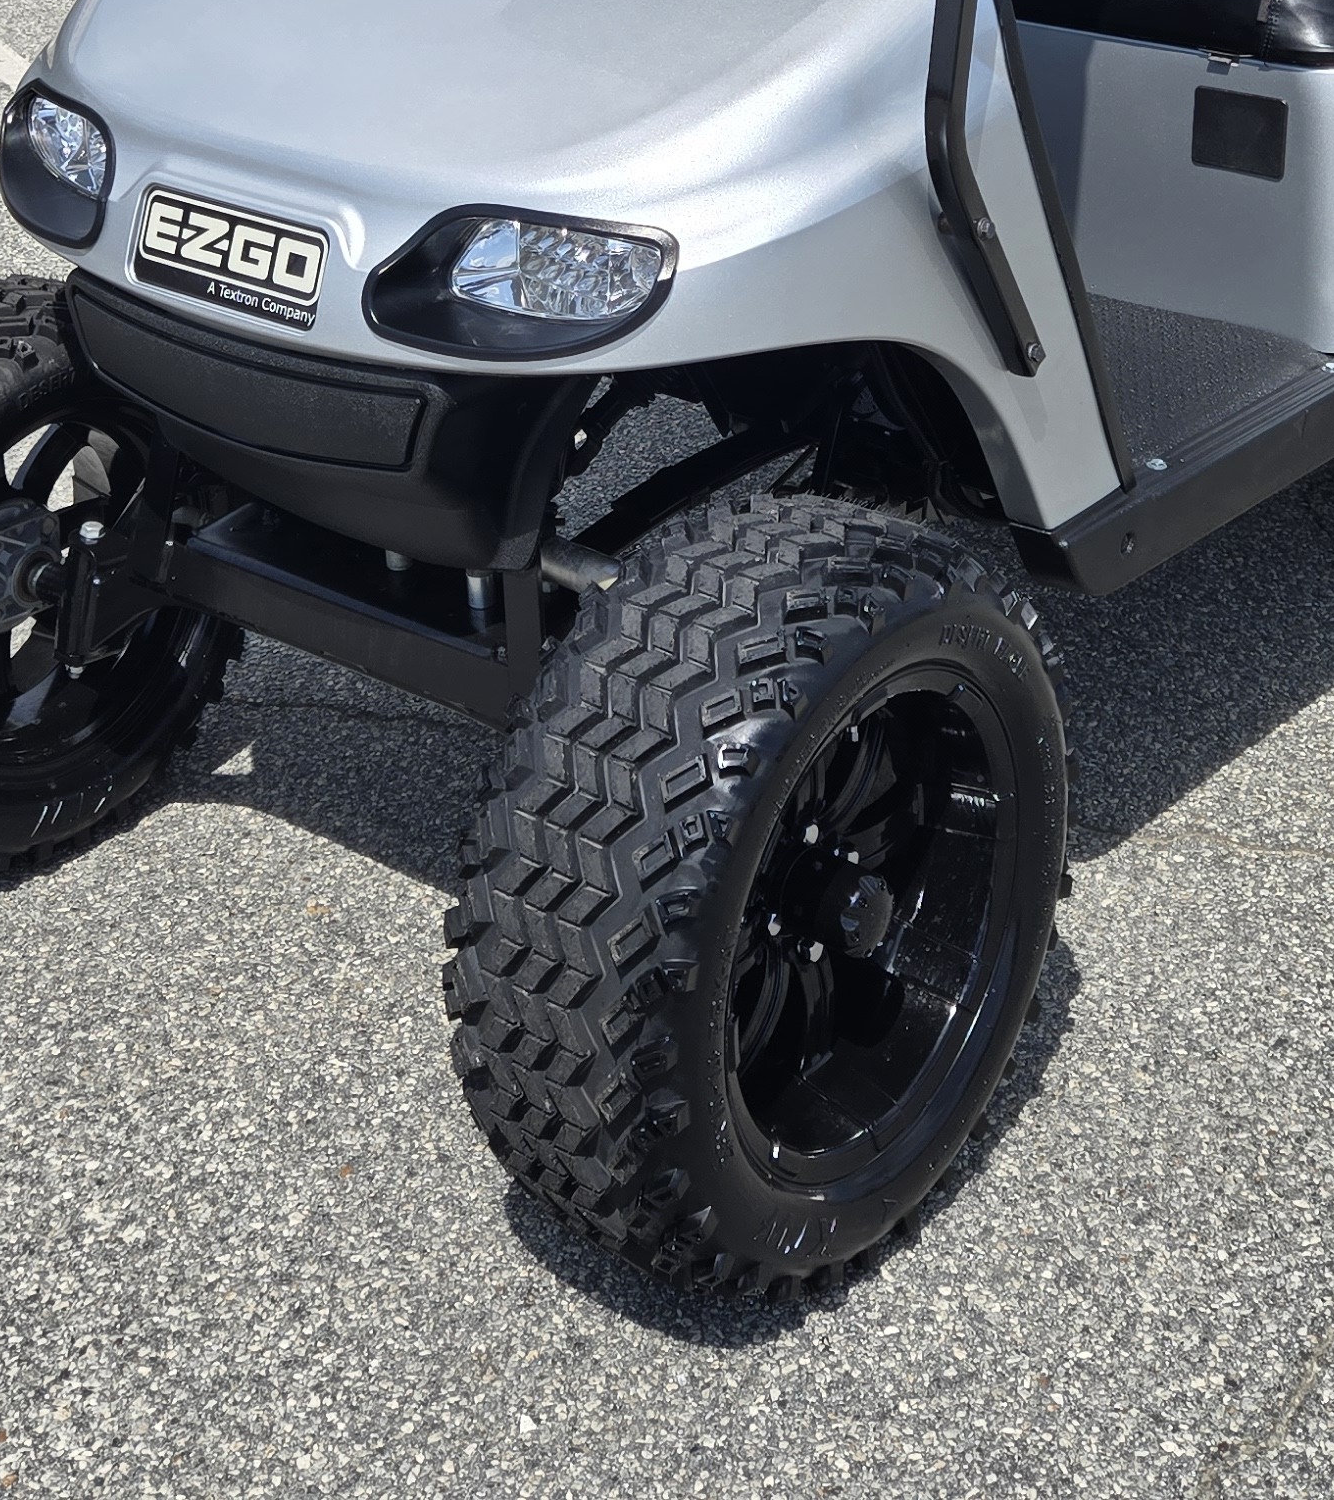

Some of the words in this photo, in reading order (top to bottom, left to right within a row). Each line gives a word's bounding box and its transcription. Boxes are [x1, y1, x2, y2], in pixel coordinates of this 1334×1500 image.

[207, 281, 216, 295] A
[219, 284, 258, 308] Textron
[261, 298, 315, 326] Company
